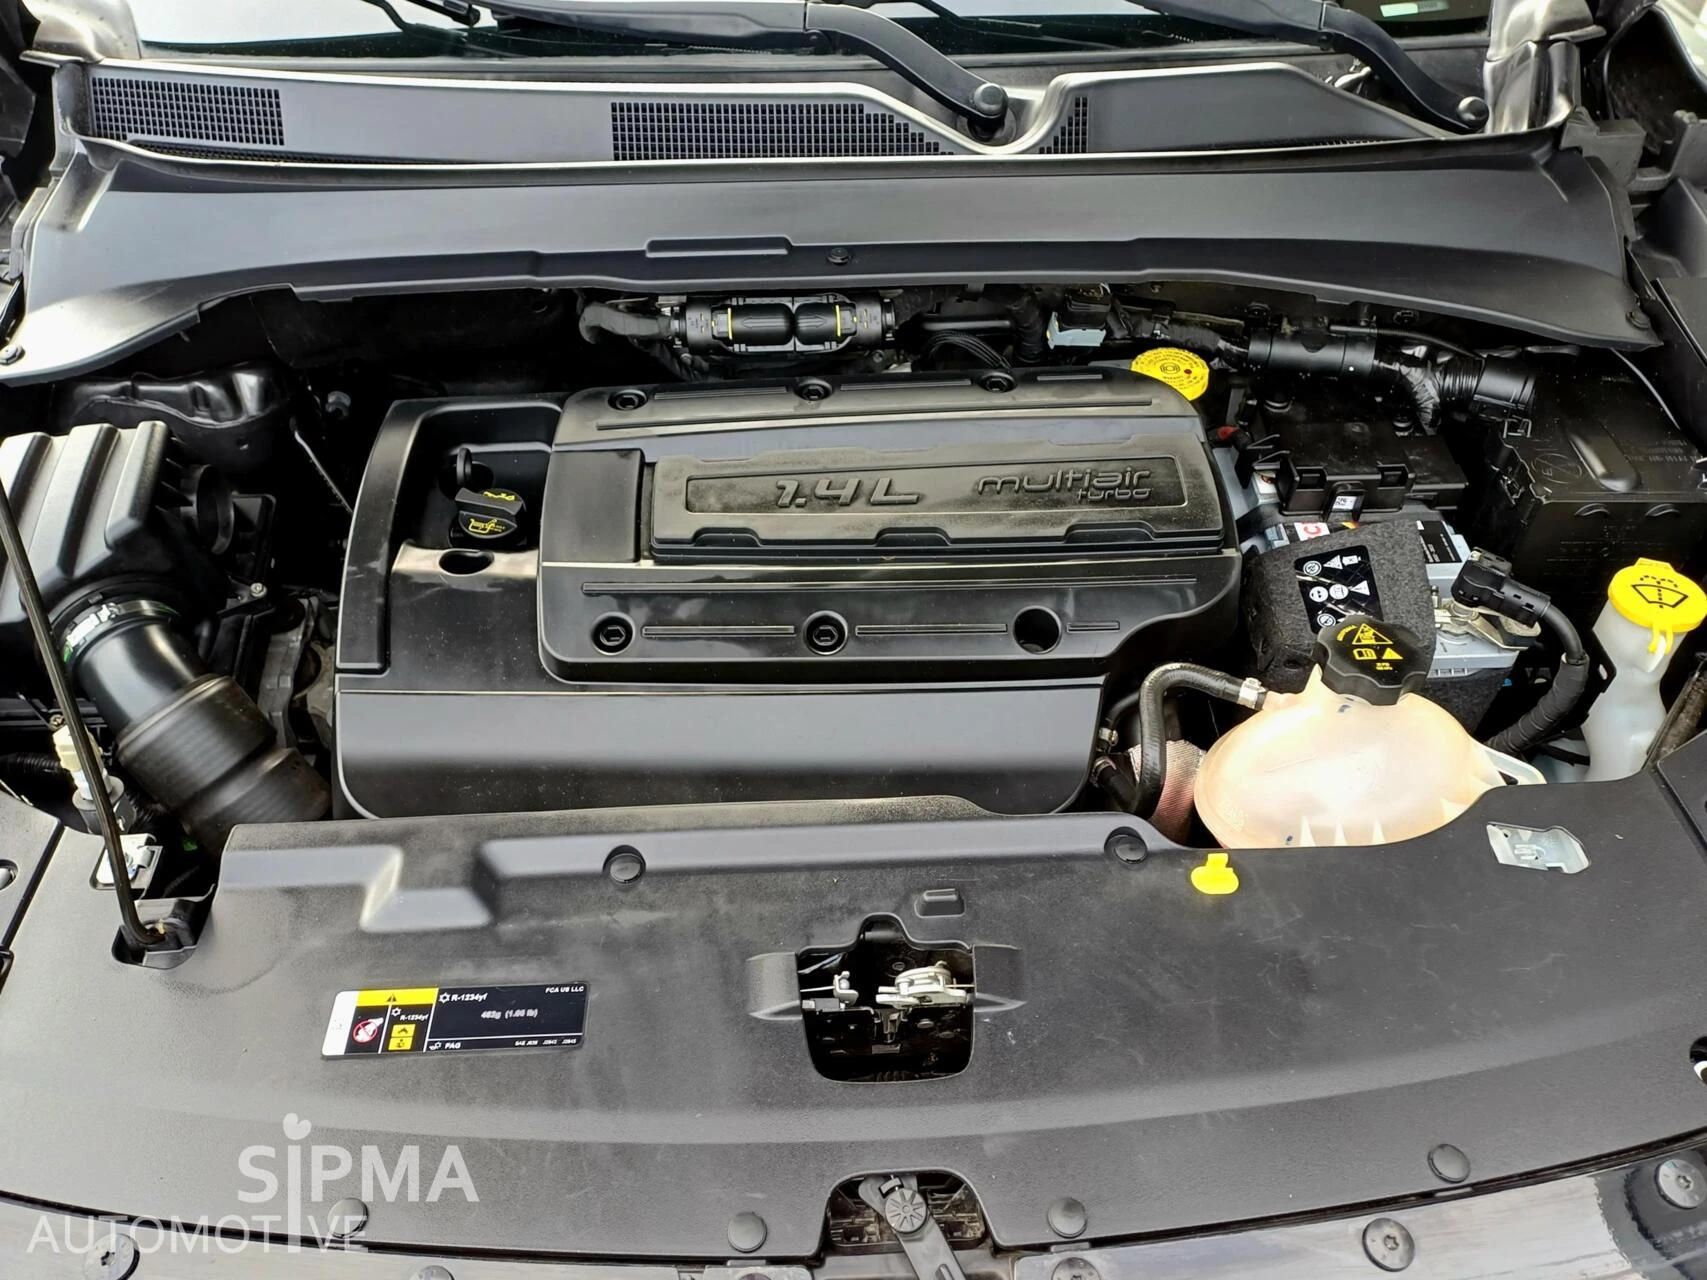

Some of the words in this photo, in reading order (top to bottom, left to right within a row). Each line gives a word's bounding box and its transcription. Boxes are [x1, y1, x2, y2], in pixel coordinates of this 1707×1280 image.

[977, 467, 1151, 495] multiair
[1077, 486, 1151, 501] turbo
[451, 993, 488, 1002] R-1234yf
